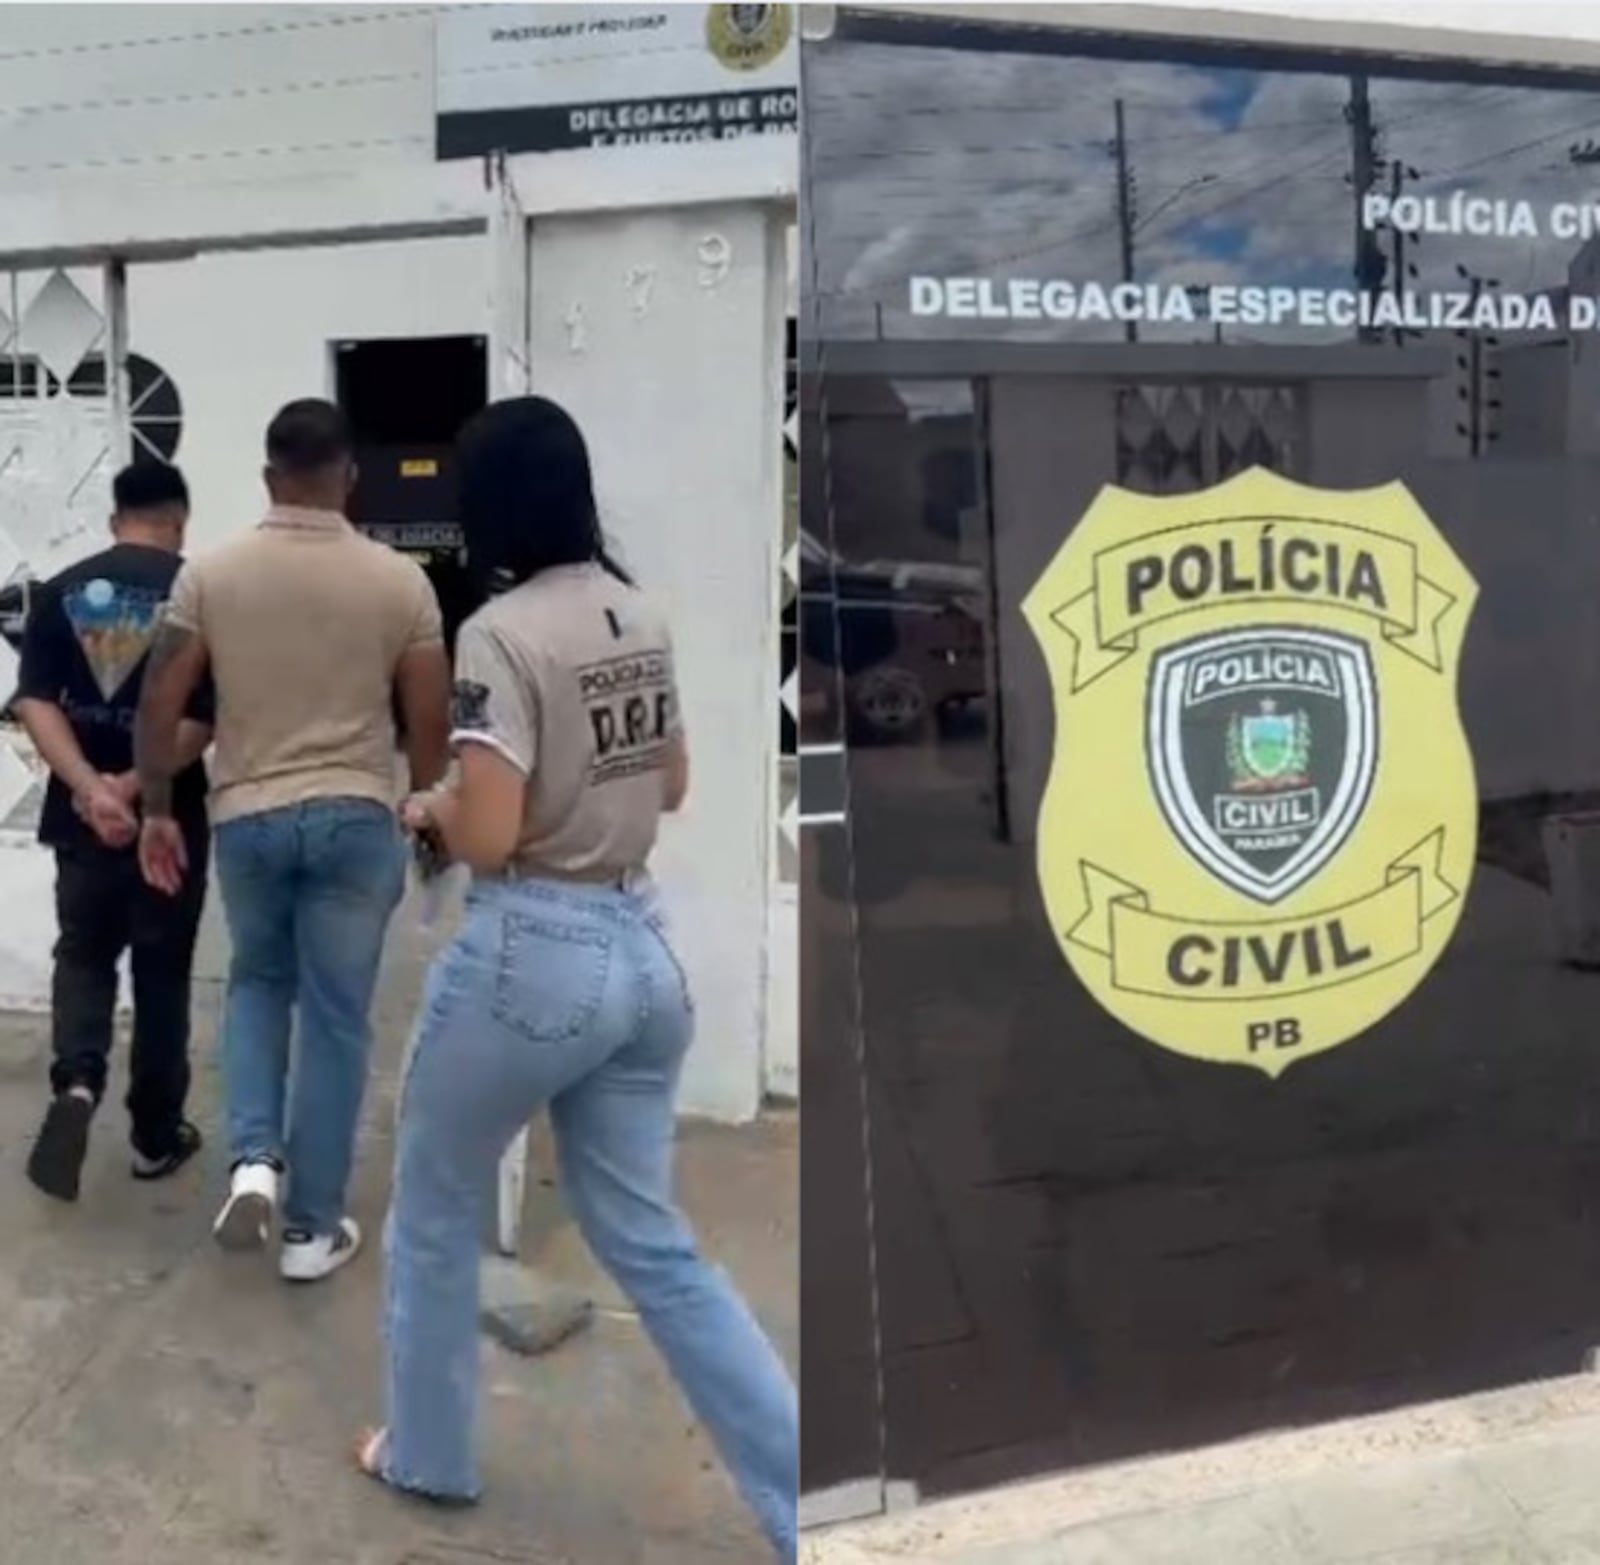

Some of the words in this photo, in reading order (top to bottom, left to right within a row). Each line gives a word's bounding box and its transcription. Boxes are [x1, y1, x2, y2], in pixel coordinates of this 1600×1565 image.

[569, 102, 711, 132] DELEGACIA
[1362, 190, 1538, 237] POLÍCIA
[909, 276, 1193, 322] DELEGACIA
[1209, 285, 1556, 330] ESPECIALIZADA
[1569, 294, 1600, 331] D
[1126, 523, 1387, 617] POLÍCIA
[1195, 647, 1330, 694] POLÍCIA
[1225, 798, 1310, 828] CIVIL
[1166, 918, 1372, 988] CIVIL
[1246, 1017, 1302, 1052] PB
